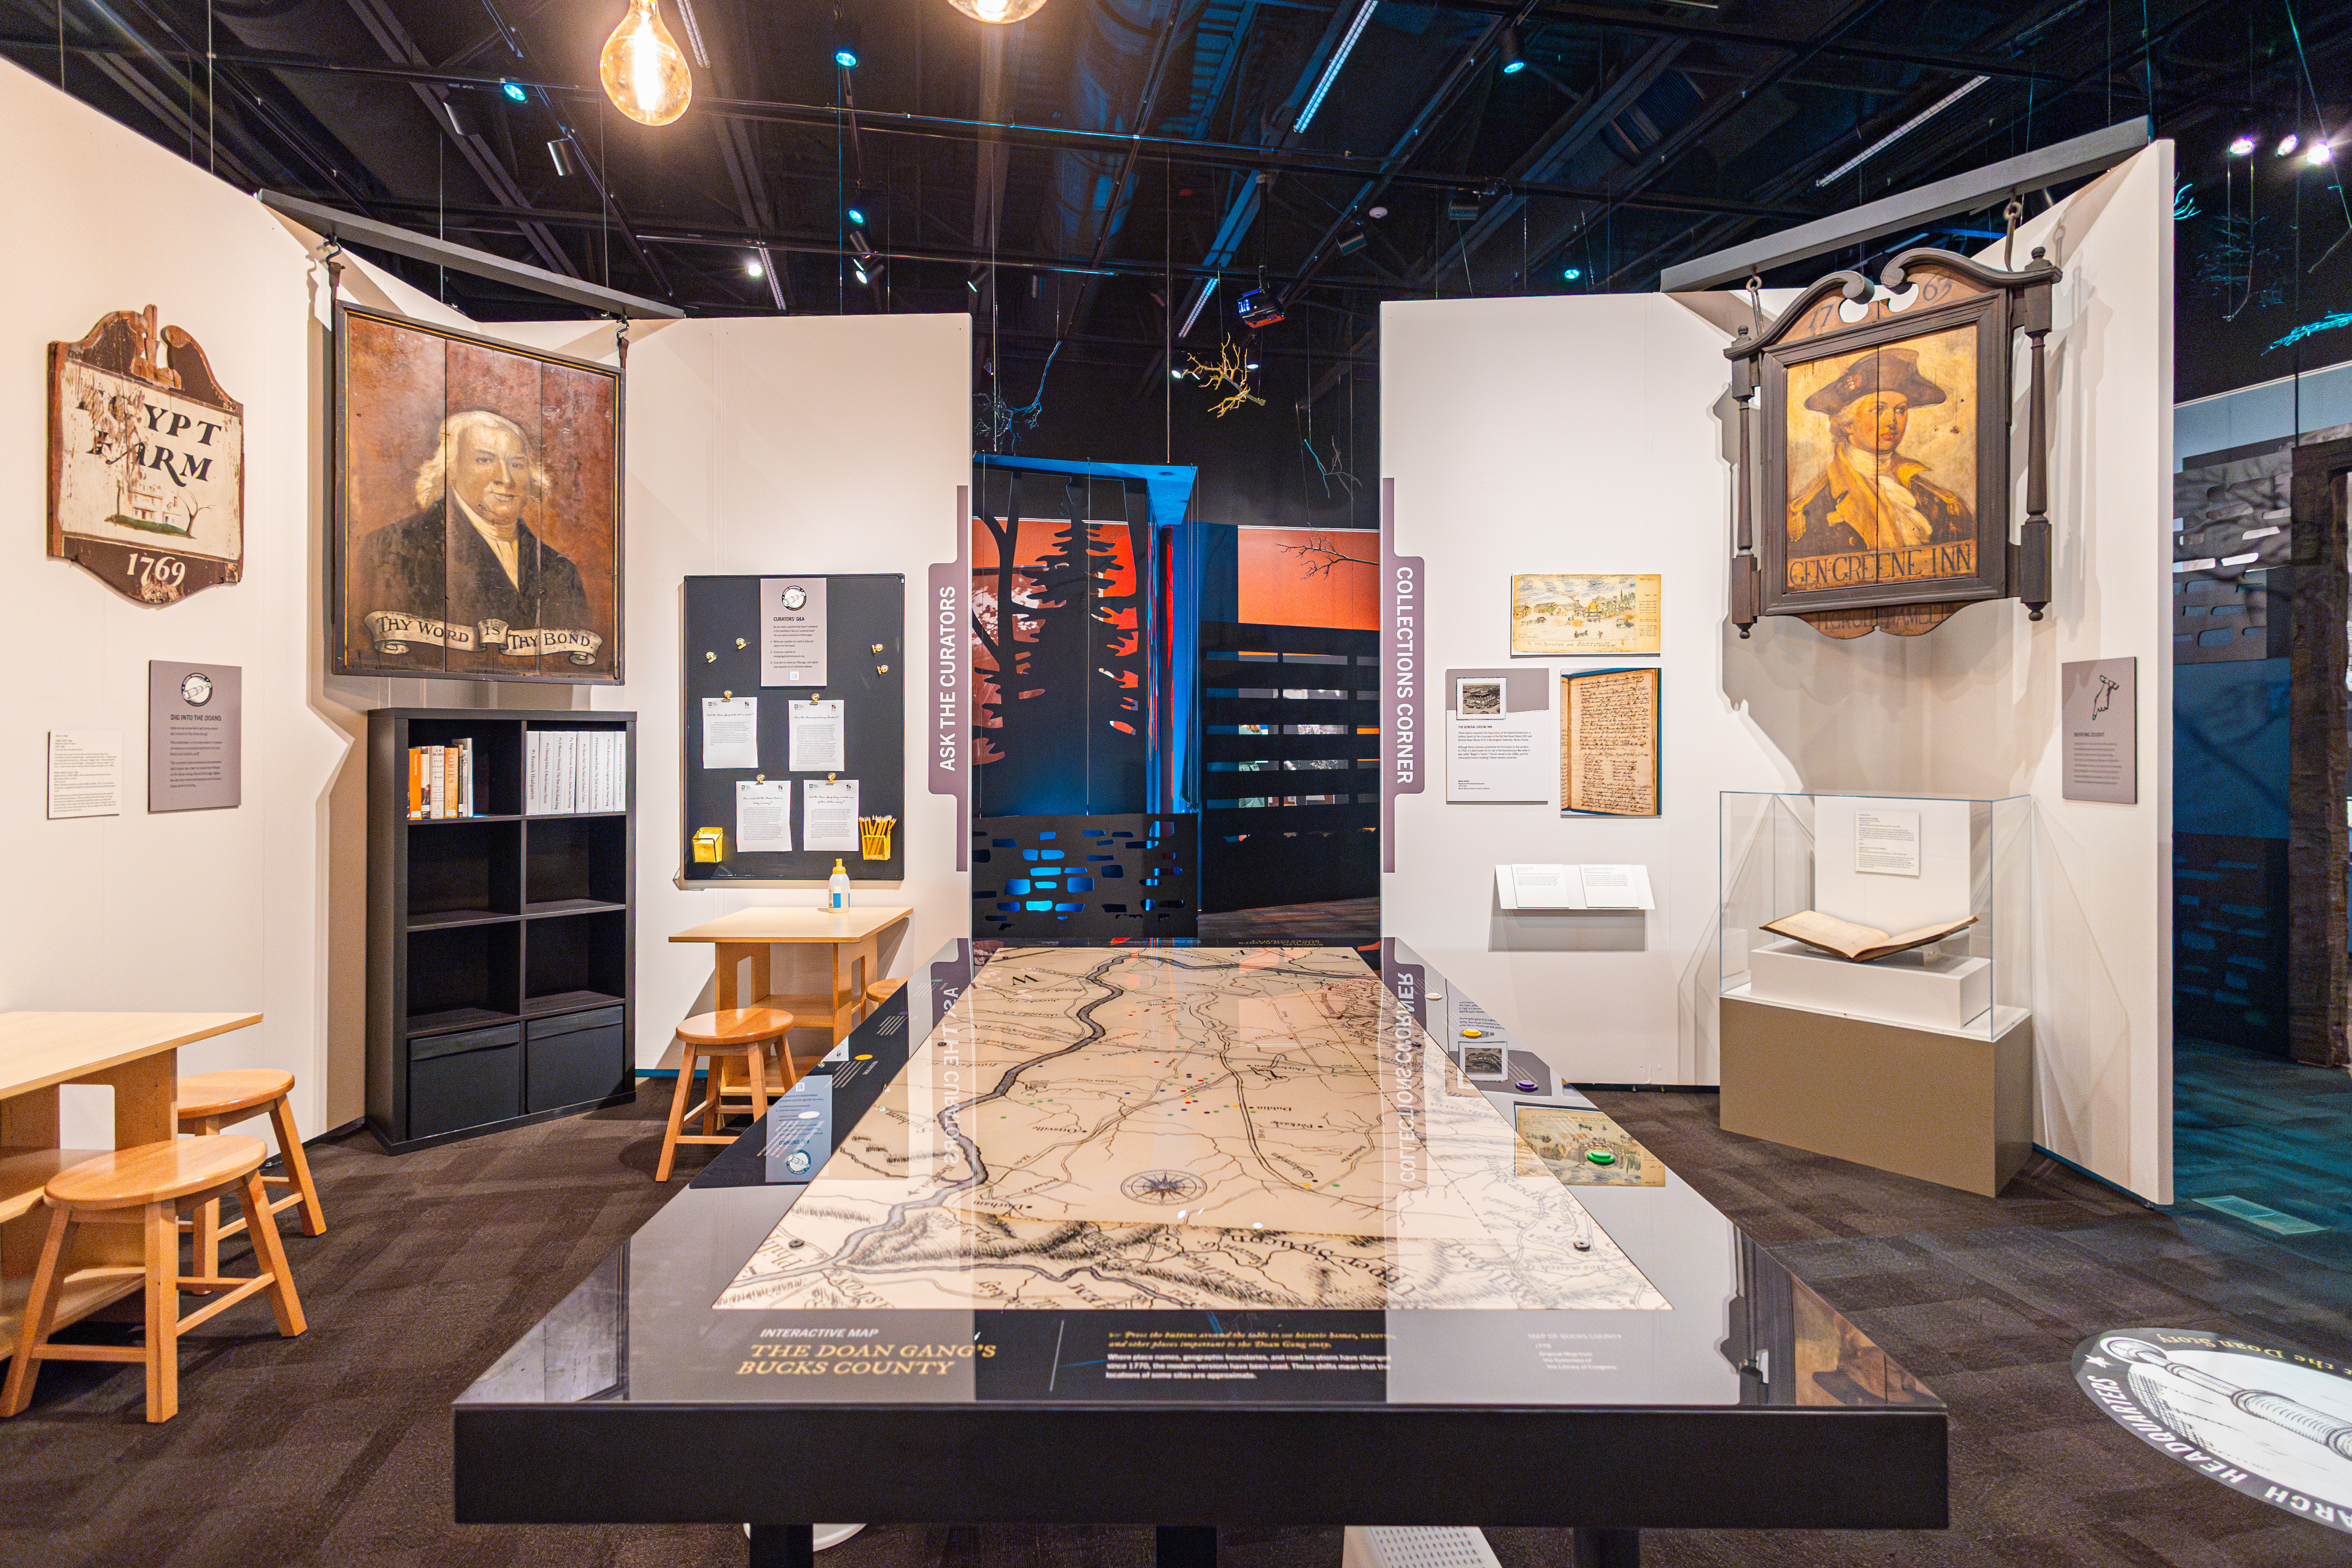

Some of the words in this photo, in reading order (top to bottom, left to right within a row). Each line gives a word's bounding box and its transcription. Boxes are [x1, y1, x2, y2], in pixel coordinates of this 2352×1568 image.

[126, 552, 185, 588] 1769
[1932, 544, 1972, 573] INN
[377, 616, 414, 633] THY
[419, 622, 469, 643] WORD
[485, 625, 501, 636] IS
[509, 634, 539, 650] THY
[543, 633, 594, 649] BOND.
[940, 586, 955, 687] CURATORS
[1397, 567, 1413, 698] COLLECTIONS
[940, 692, 955, 729] THE
[940, 733, 955, 771] ASK
[1397, 704, 1413, 784] CORNER
[973, 1201, 1023, 1210] Durham
[1230, 1234, 1334, 1262] Saucon
[760, 1328, 847, 1338] INTERACTIVE
[848, 1328, 879, 1338] MAP
[2157, 1333, 2217, 1348] Story
[750, 1344, 812, 1358] THE
[814, 1344, 897, 1358] DOAN
[899, 1344, 997, 1358] GANG'S
[2219, 1339, 2285, 1360] Doan
[735, 1361, 828, 1375] BUCKS
[833, 1361, 956, 1375] COUNTY
[2087, 1375, 2248, 1484] HEADQUARTERS
